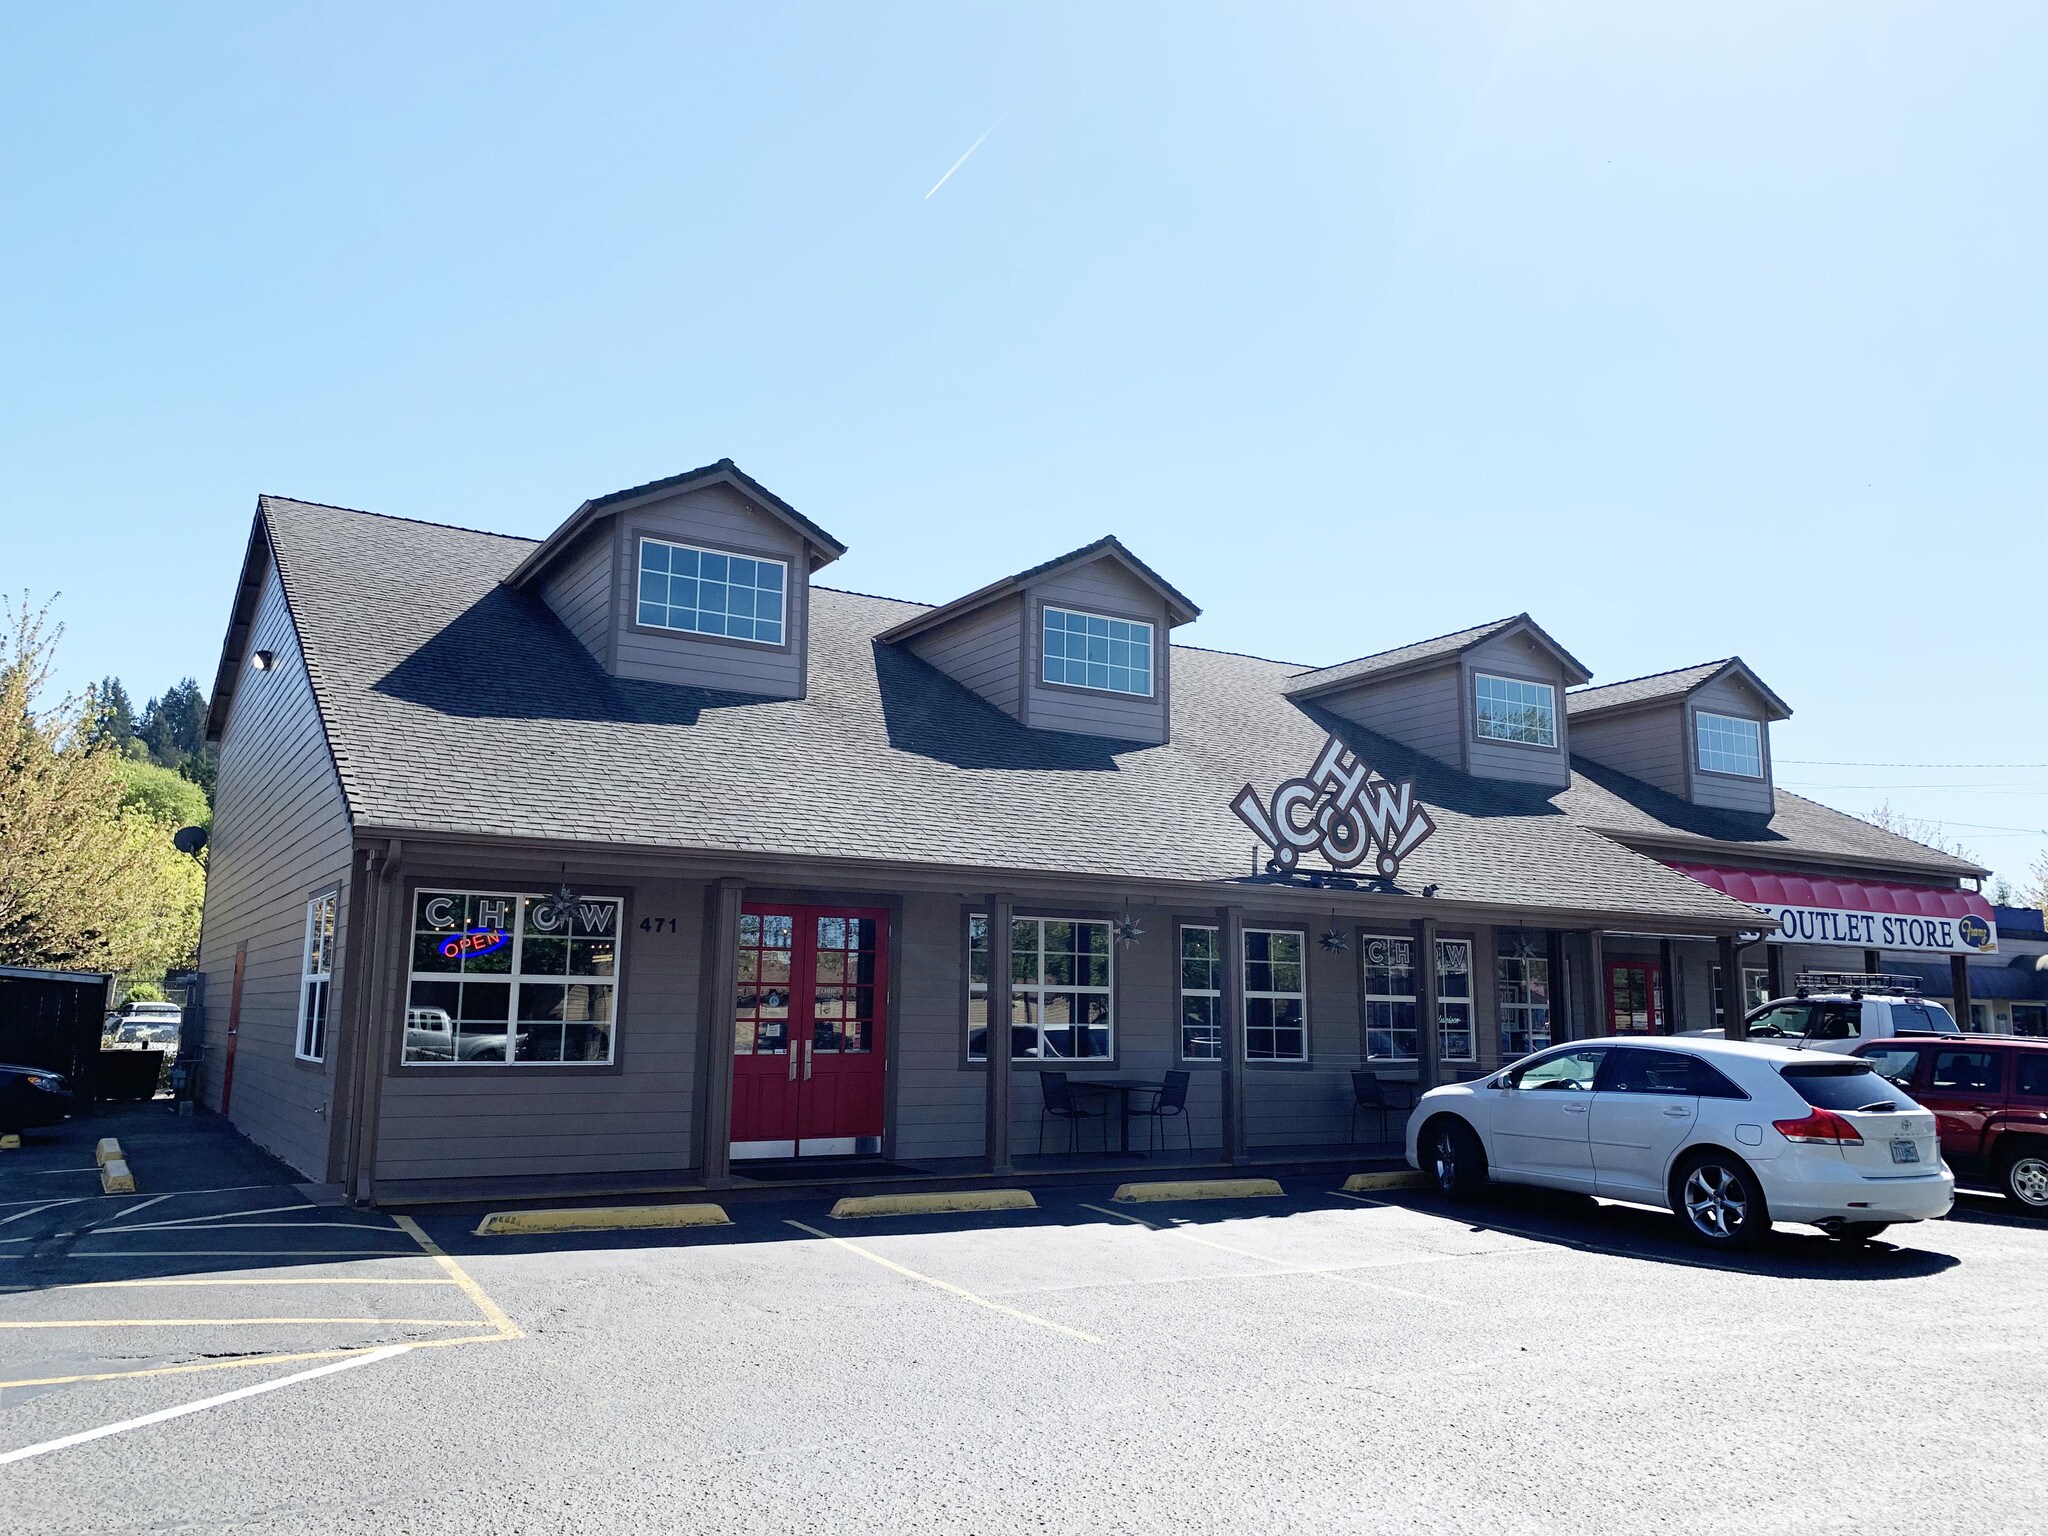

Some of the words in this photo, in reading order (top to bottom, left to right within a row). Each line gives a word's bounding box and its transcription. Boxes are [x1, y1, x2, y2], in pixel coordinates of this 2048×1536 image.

[639, 917, 677, 934] 471
[1780, 908, 1875, 943] OUTLET
[1883, 917, 1954, 948] STORE
[444, 931, 500, 959] OPEN
[1368, 941, 1466, 966] CHW
